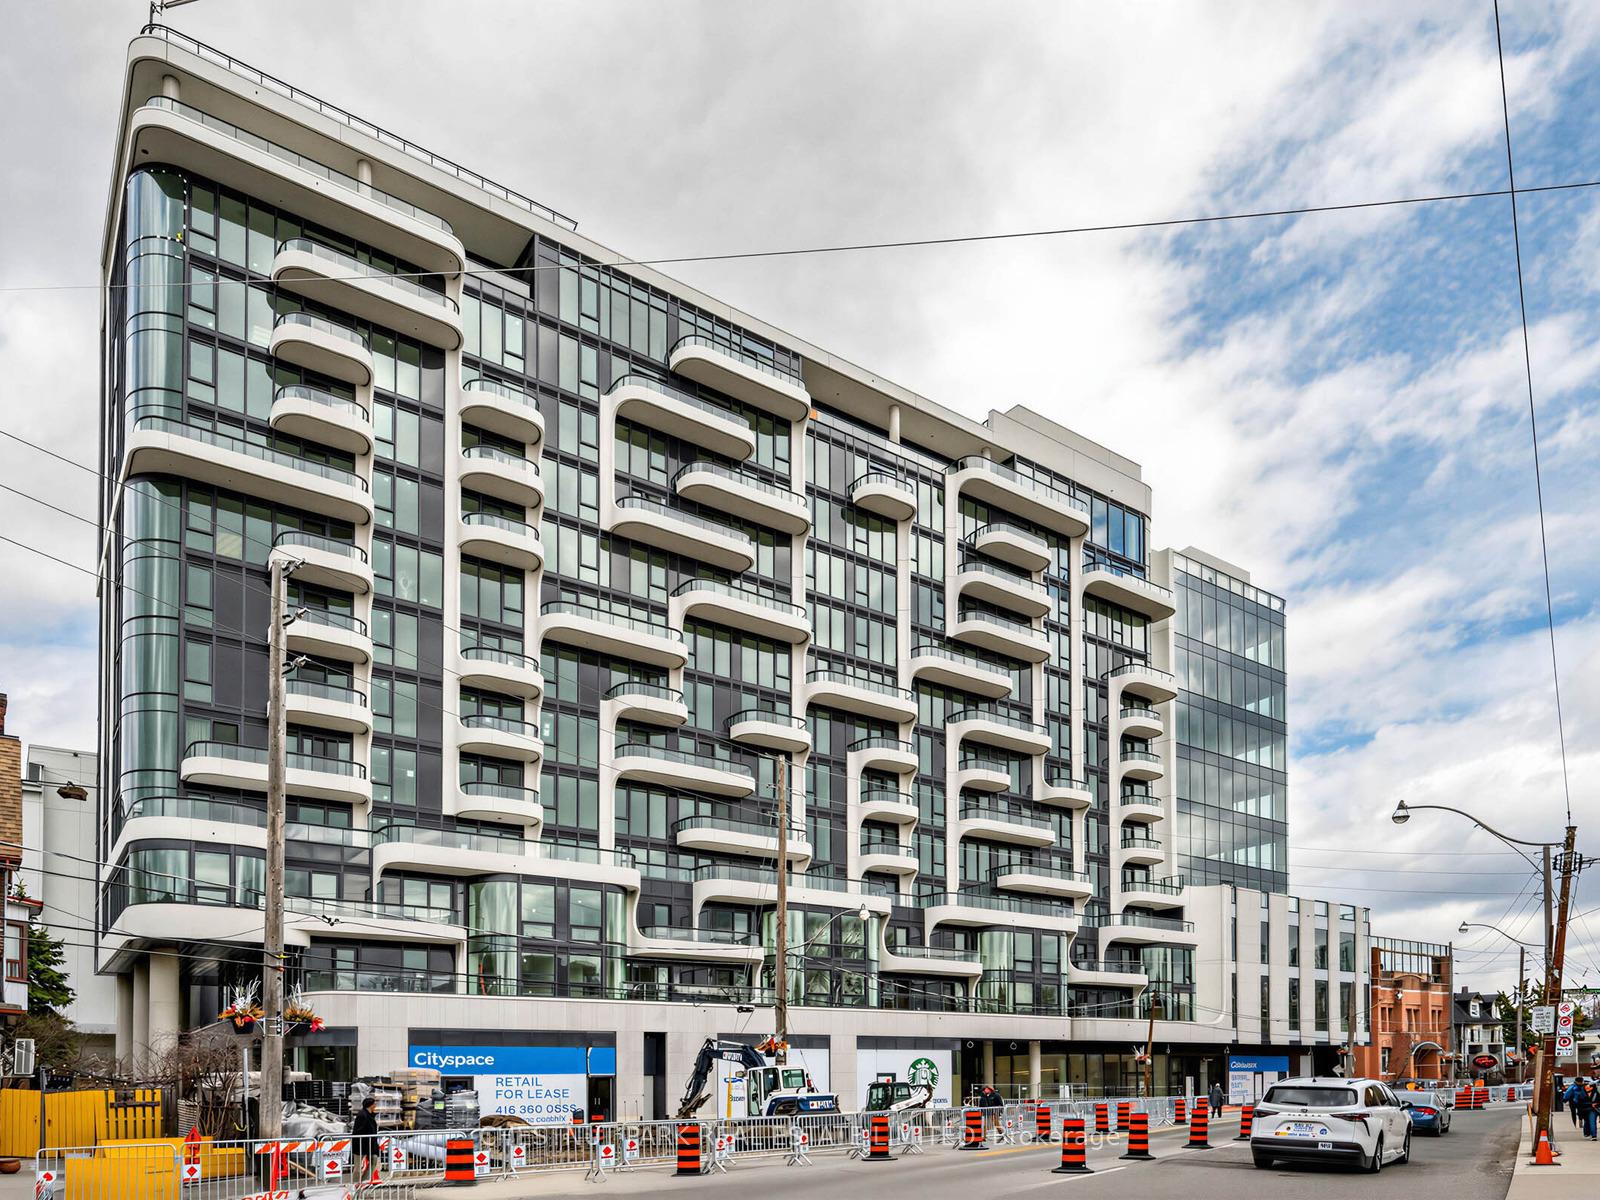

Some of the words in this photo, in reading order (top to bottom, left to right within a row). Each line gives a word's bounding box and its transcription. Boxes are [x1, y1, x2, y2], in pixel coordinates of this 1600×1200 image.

[414, 1052, 495, 1068] Cityspace
[495, 1077, 543, 1087] RETAIL
[495, 1089, 524, 1099] FOR
[527, 1088, 570, 1099] LEASE
[495, 1105, 516, 1115] 416
[519, 1104, 543, 1114] 360
